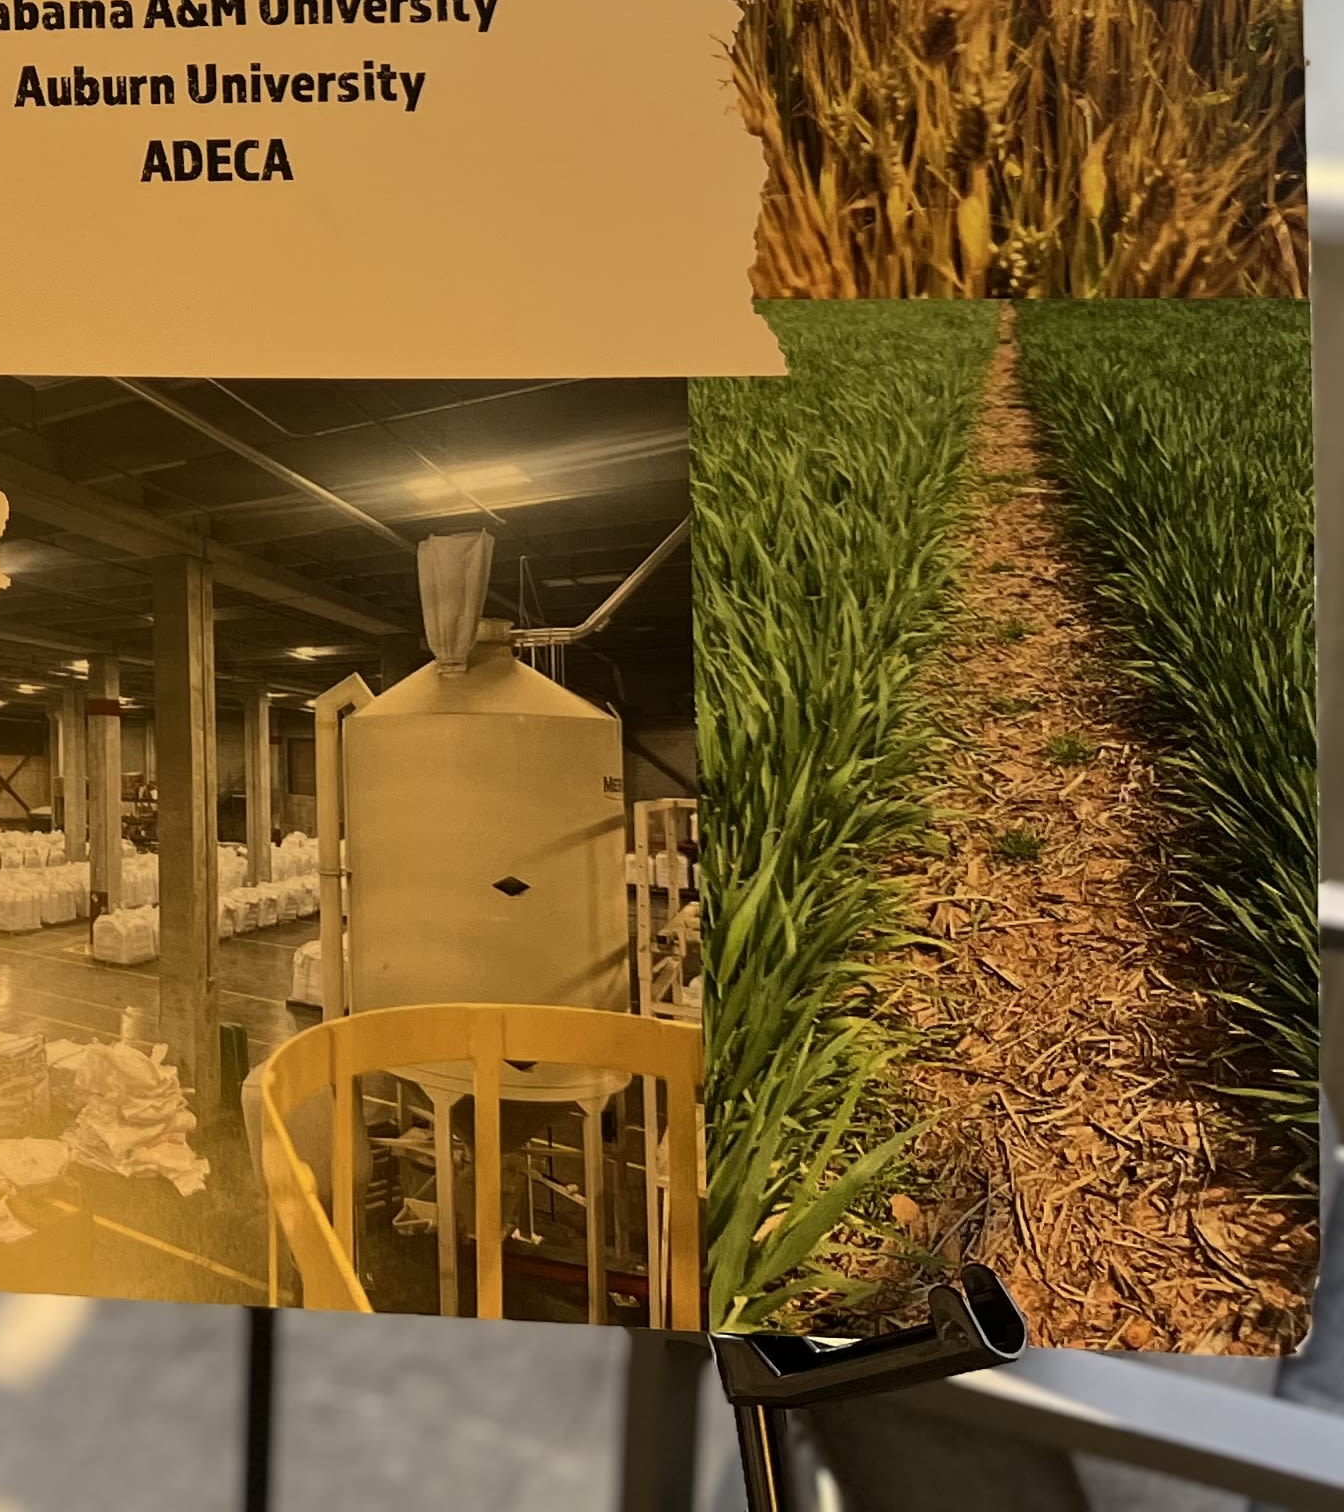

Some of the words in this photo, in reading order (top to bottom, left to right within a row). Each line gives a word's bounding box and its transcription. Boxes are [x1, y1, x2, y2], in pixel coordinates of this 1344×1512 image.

[13, 64, 176, 109] Auburn
[185, 59, 427, 113] University
[139, 137, 295, 183] ADECA
